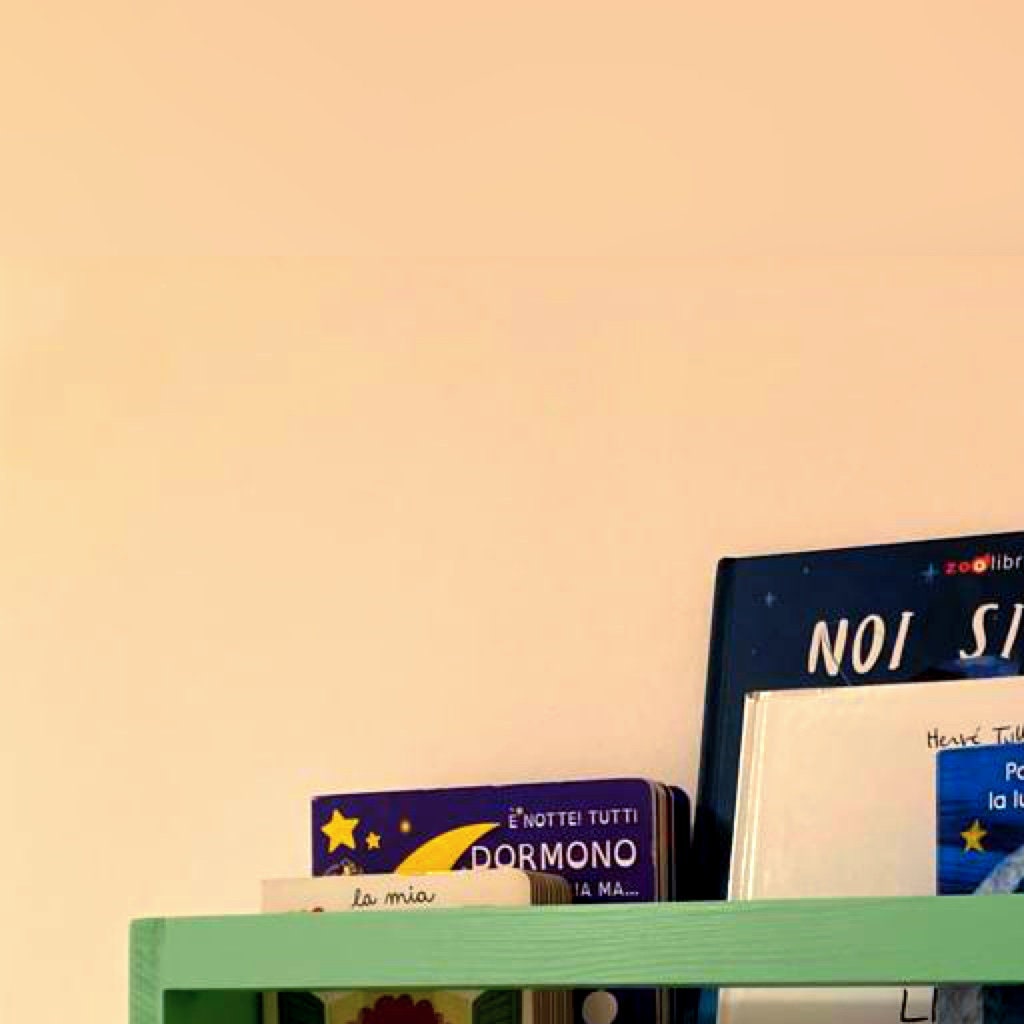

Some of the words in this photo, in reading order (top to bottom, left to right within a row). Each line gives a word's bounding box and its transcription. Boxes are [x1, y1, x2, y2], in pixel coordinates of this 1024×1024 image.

[808, 611, 914, 676] NOI
[989, 791, 1007, 811] la
[587, 807, 639, 825] TUTTI
[471, 838, 638, 871] DORMONO
[352, 887, 377, 907] la
[383, 885, 436, 906] mia
[599, 881, 639, 897] MA...
